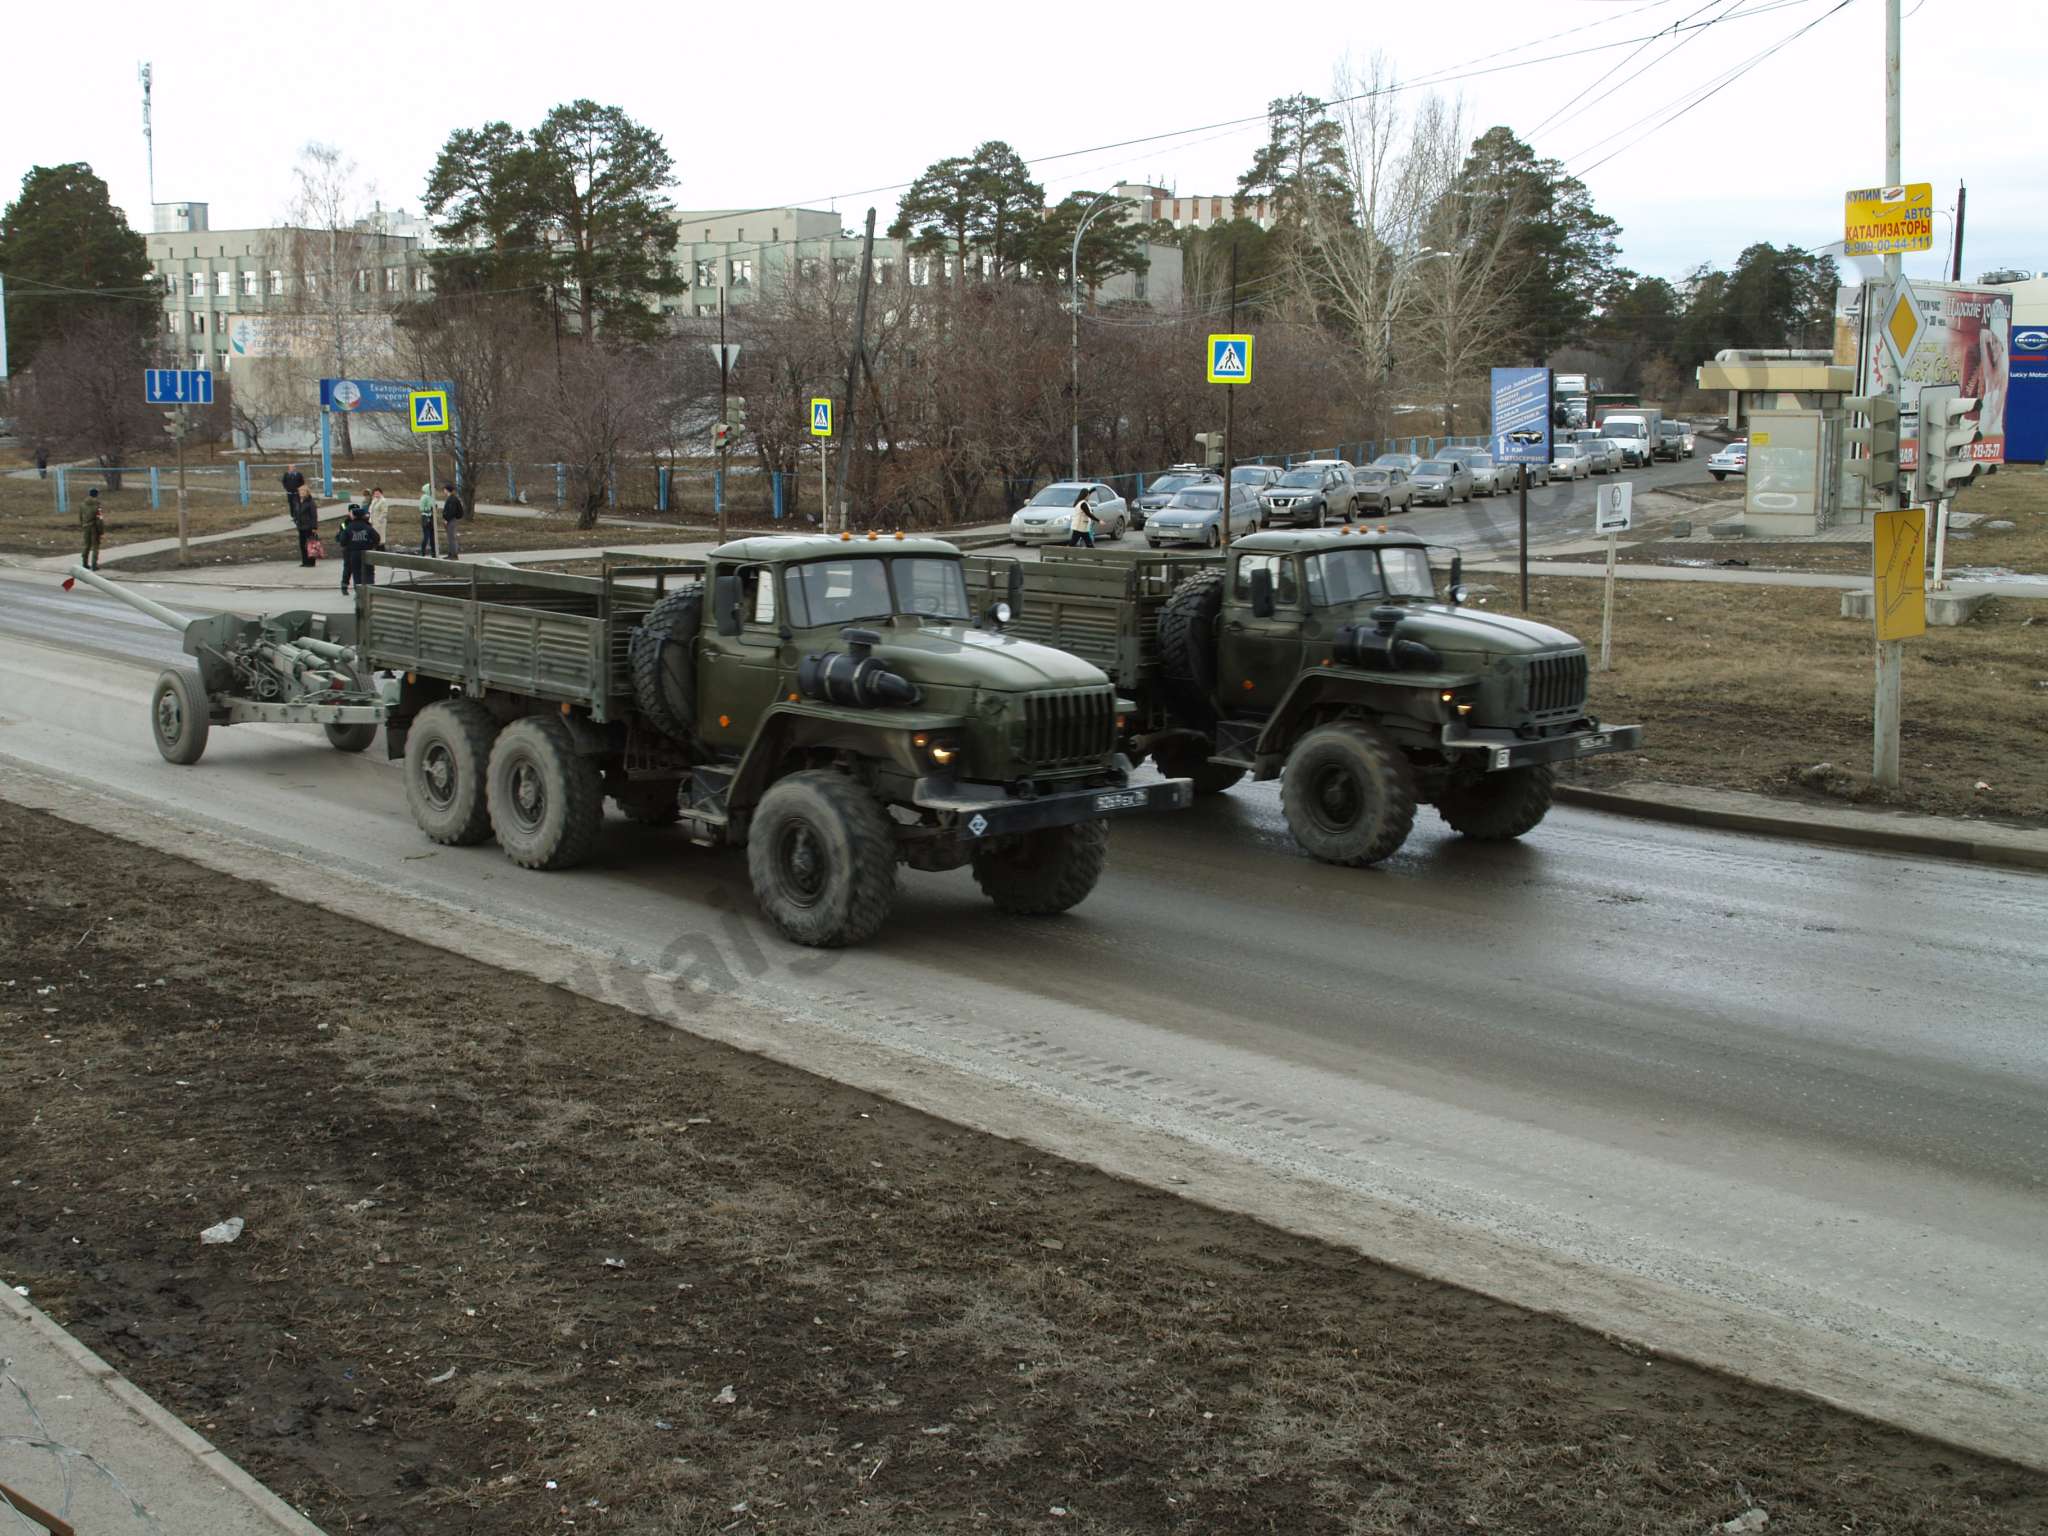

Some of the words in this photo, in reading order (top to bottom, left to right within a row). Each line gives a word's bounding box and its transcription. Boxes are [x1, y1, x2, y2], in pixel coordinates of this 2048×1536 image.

[1847, 189, 1880, 203] КУПИМ
[1904, 207, 1932, 220] АВТО
[1846, 220, 1931, 240] КАТАЛИЗАТОРЫ
